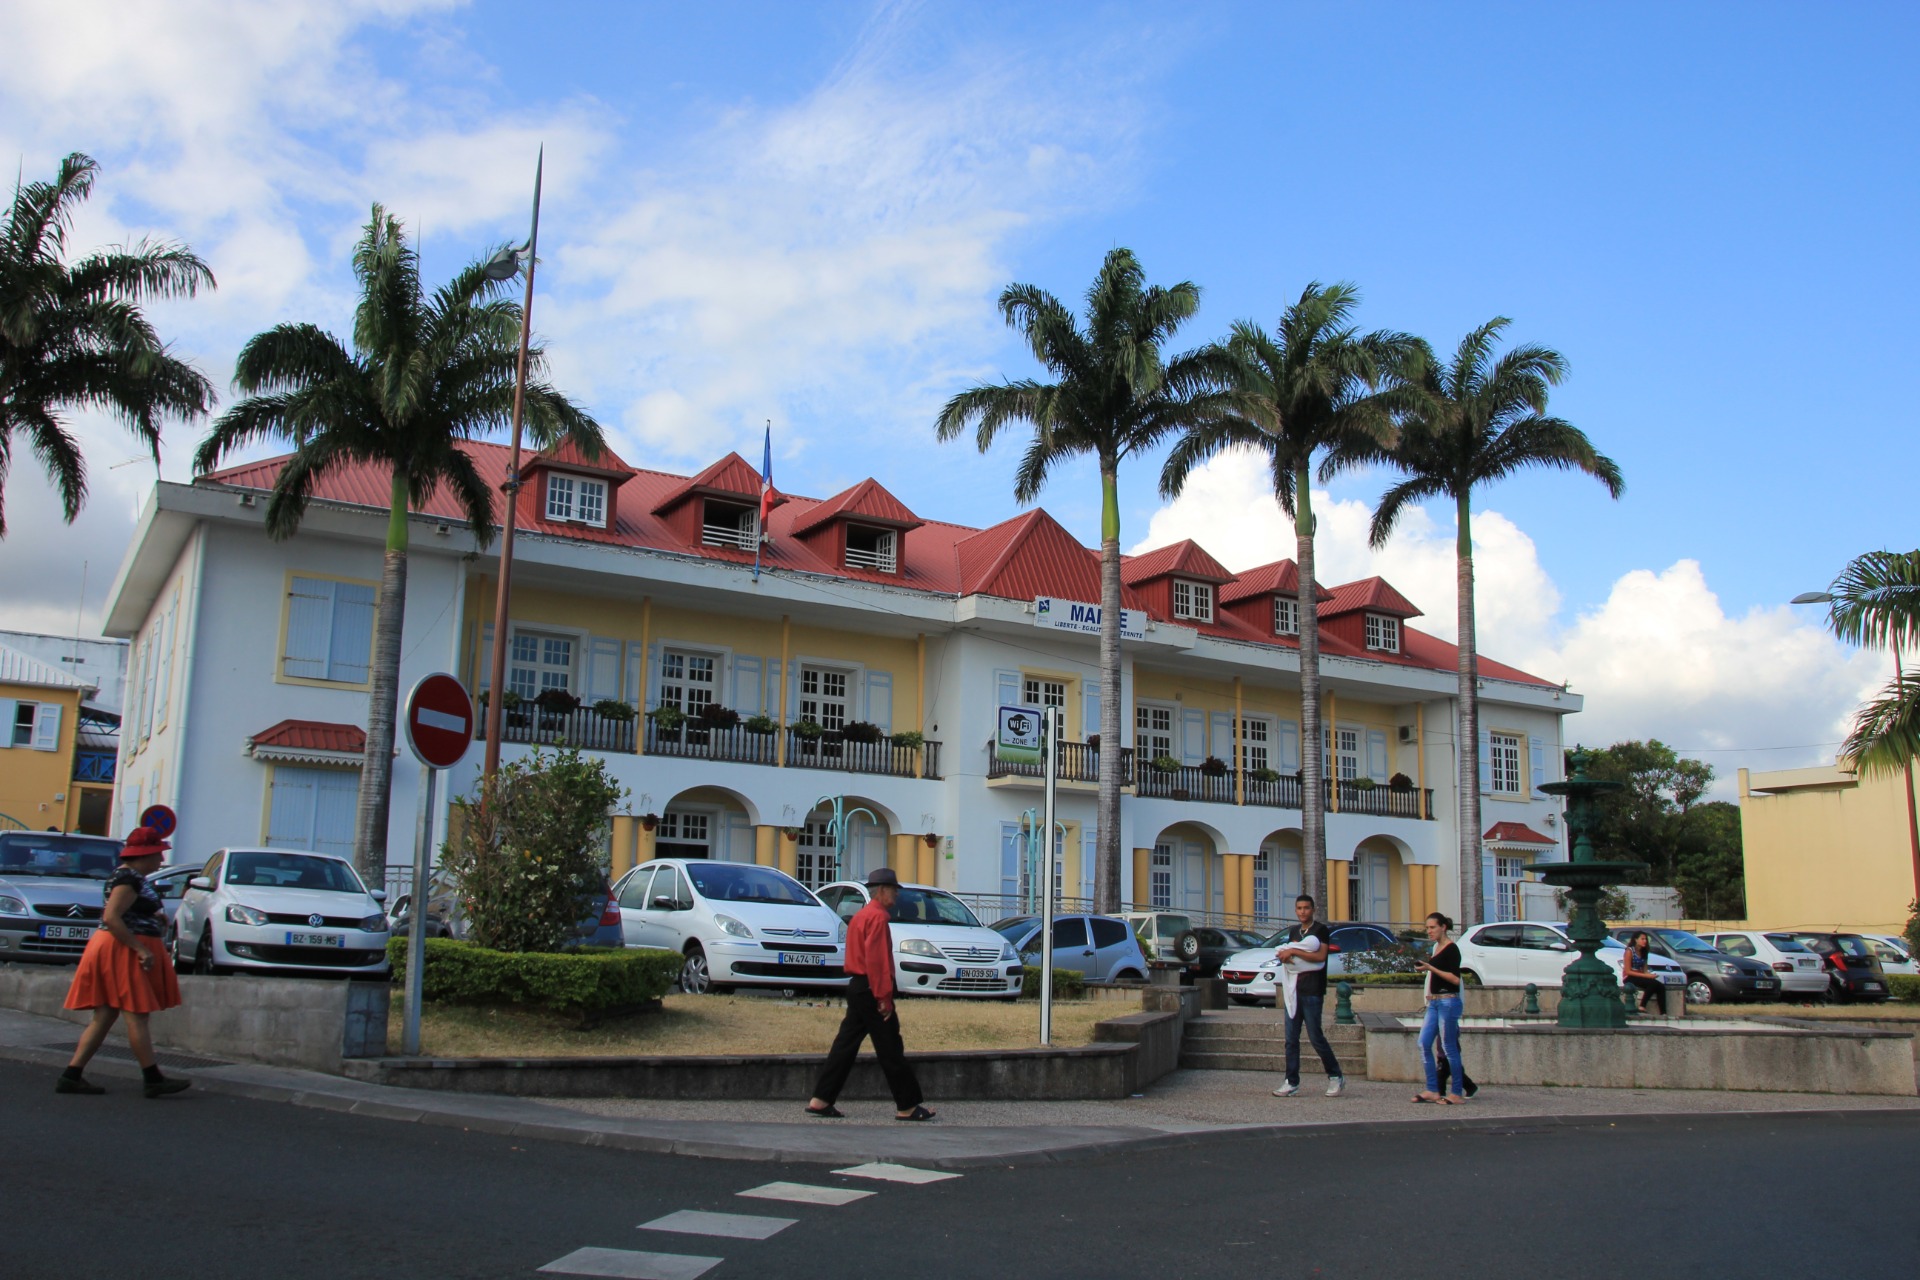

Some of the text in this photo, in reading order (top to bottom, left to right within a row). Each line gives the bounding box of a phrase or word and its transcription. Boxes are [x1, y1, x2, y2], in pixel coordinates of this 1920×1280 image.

[1070, 604, 1128, 628] MAIE
[1082, 624, 1101, 632] EGALIT
[1012, 737, 1028, 745] ZONE
[47, 926, 90, 938] 59 BMB
